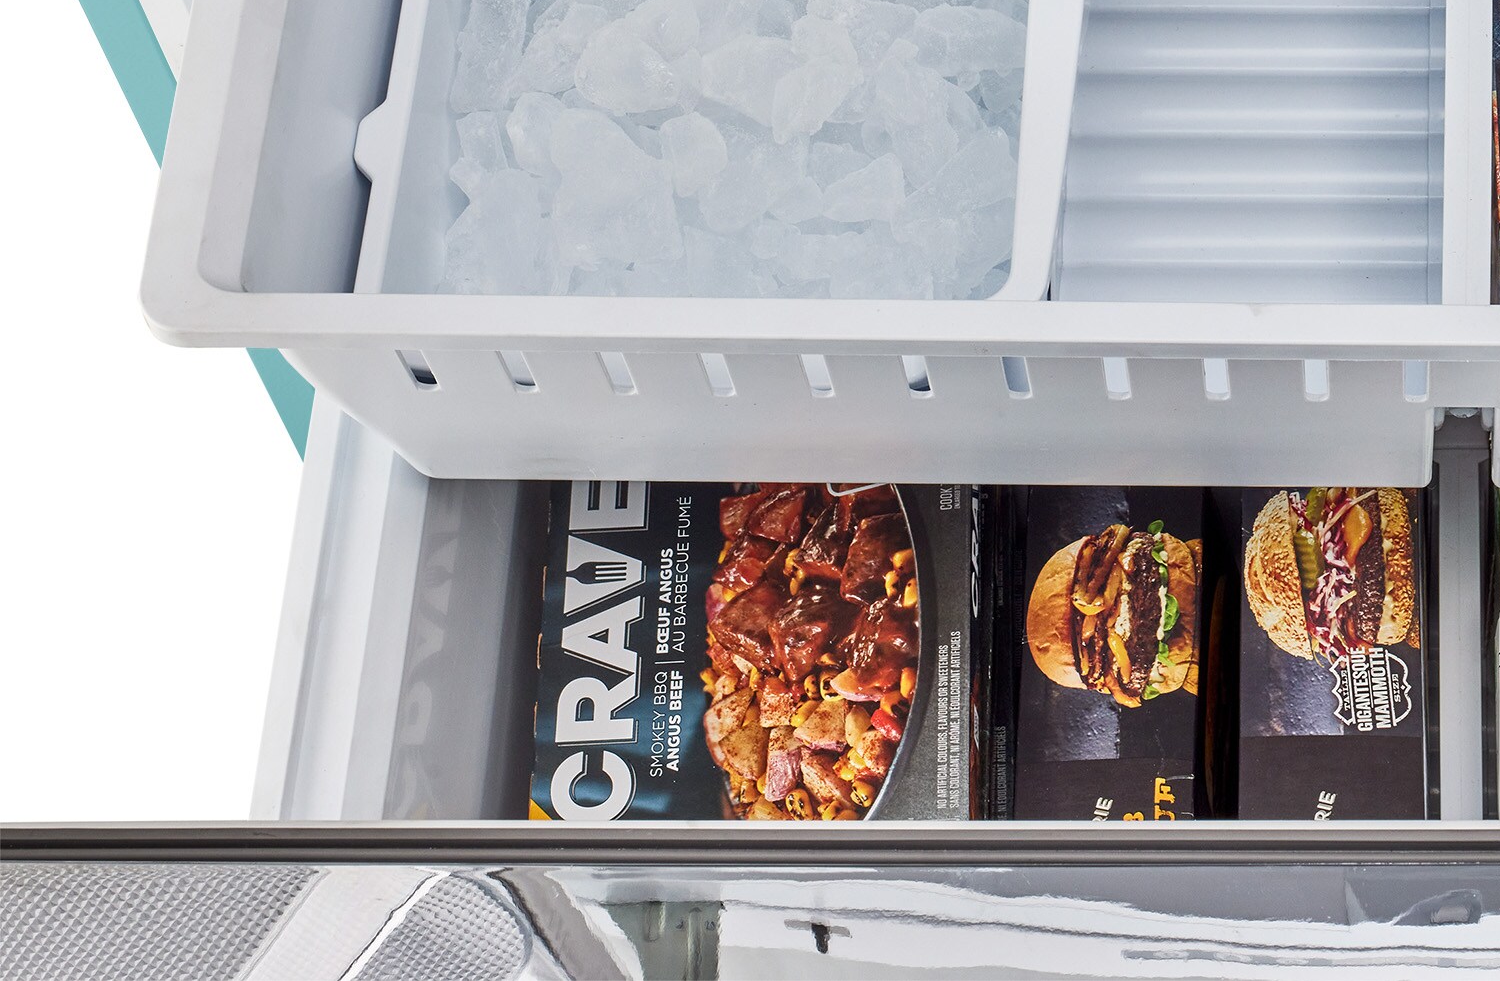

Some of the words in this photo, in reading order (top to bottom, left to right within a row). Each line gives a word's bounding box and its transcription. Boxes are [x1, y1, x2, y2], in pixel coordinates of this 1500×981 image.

[677, 496, 691, 537] FUMÉ
[940, 487, 953, 511] COOK
[658, 548, 673, 603] ANGUS
[673, 542, 689, 625] BARBECUE
[550, 481, 649, 820] CRAVE
[655, 607, 670, 653] BŒUF
[671, 630, 685, 652] AU
[937, 644, 948, 686] SWEETENERS
[653, 671, 667, 705] BBQ
[668, 670, 683, 710] BEEF
[937, 686, 948, 696] OR
[1341, 669, 1351, 711] TAILLE
[1350, 646, 1374, 732] GIGANTESQUE
[1368, 647, 1392, 729] MAMMOTH
[1391, 673, 1401, 703] SIZE
[937, 696, 948, 729] FLAVOURS
[649, 710, 665, 776] SMOKEY
[666, 714, 681, 771] ANGUS
[936, 730, 948, 762] COLOURS,
[936, 763, 947, 797] ARTIFICIAL
[936, 798, 947, 808] NO
